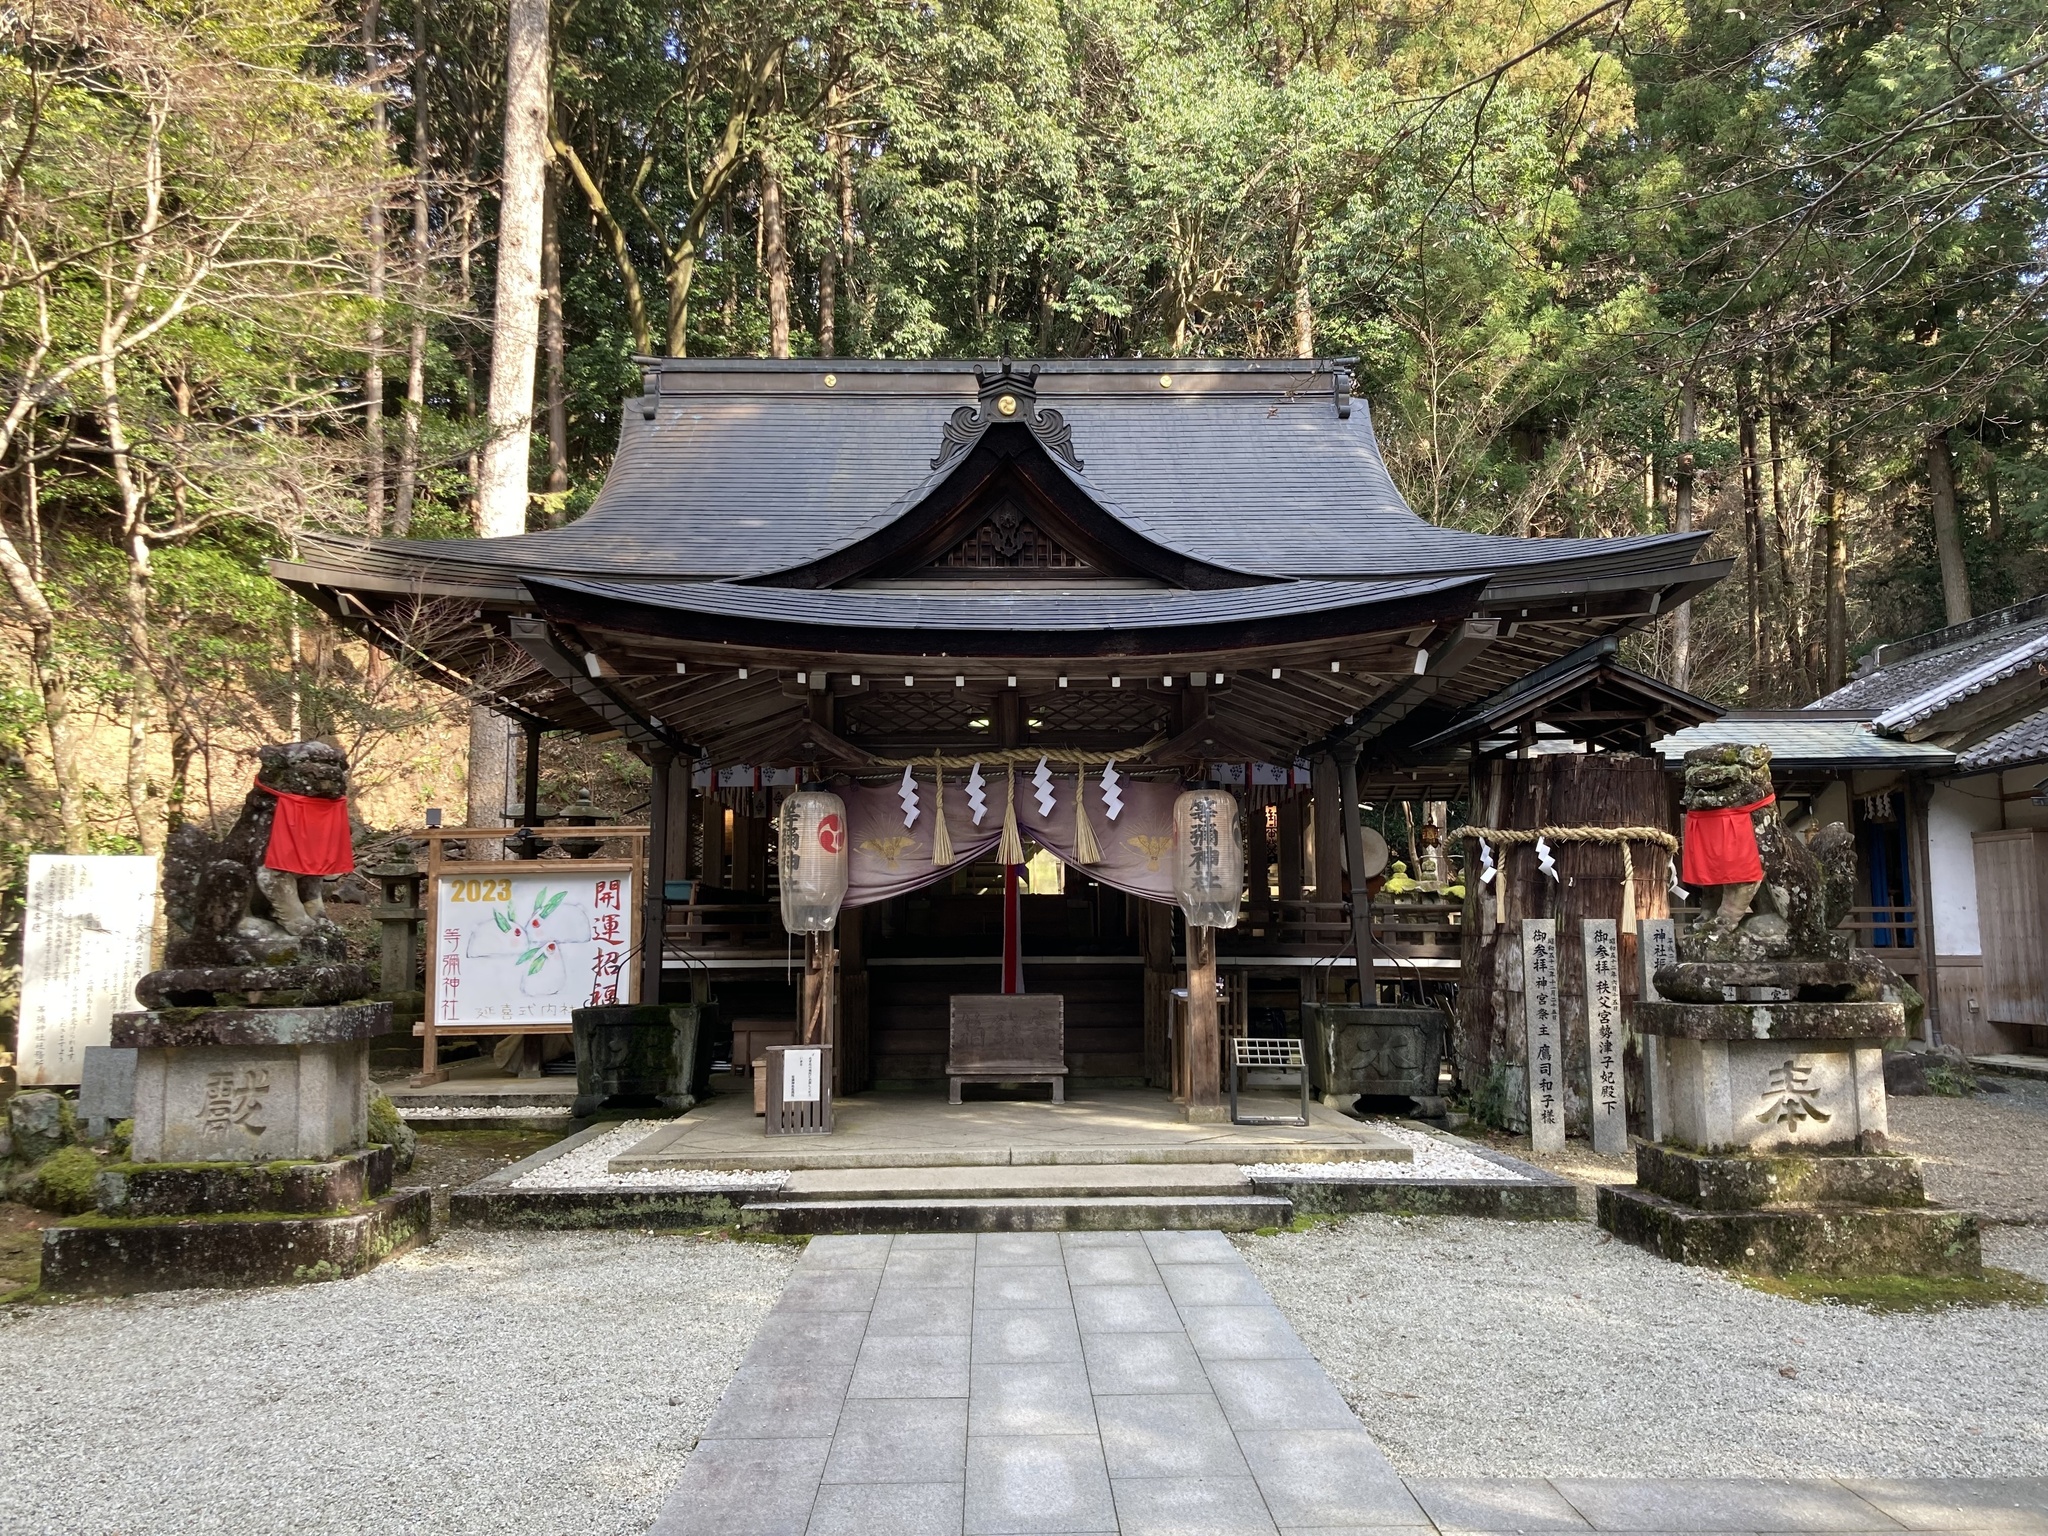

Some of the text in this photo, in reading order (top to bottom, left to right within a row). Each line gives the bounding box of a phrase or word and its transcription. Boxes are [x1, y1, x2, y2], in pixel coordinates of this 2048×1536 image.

[451, 879, 512, 902] 2023
[1189, 797, 1222, 891] 等彌神社
[441, 928, 461, 1021] 等彌神社
[592, 880, 624, 1007] 開運招福
[1756, 1060, 1832, 1133] 奉
